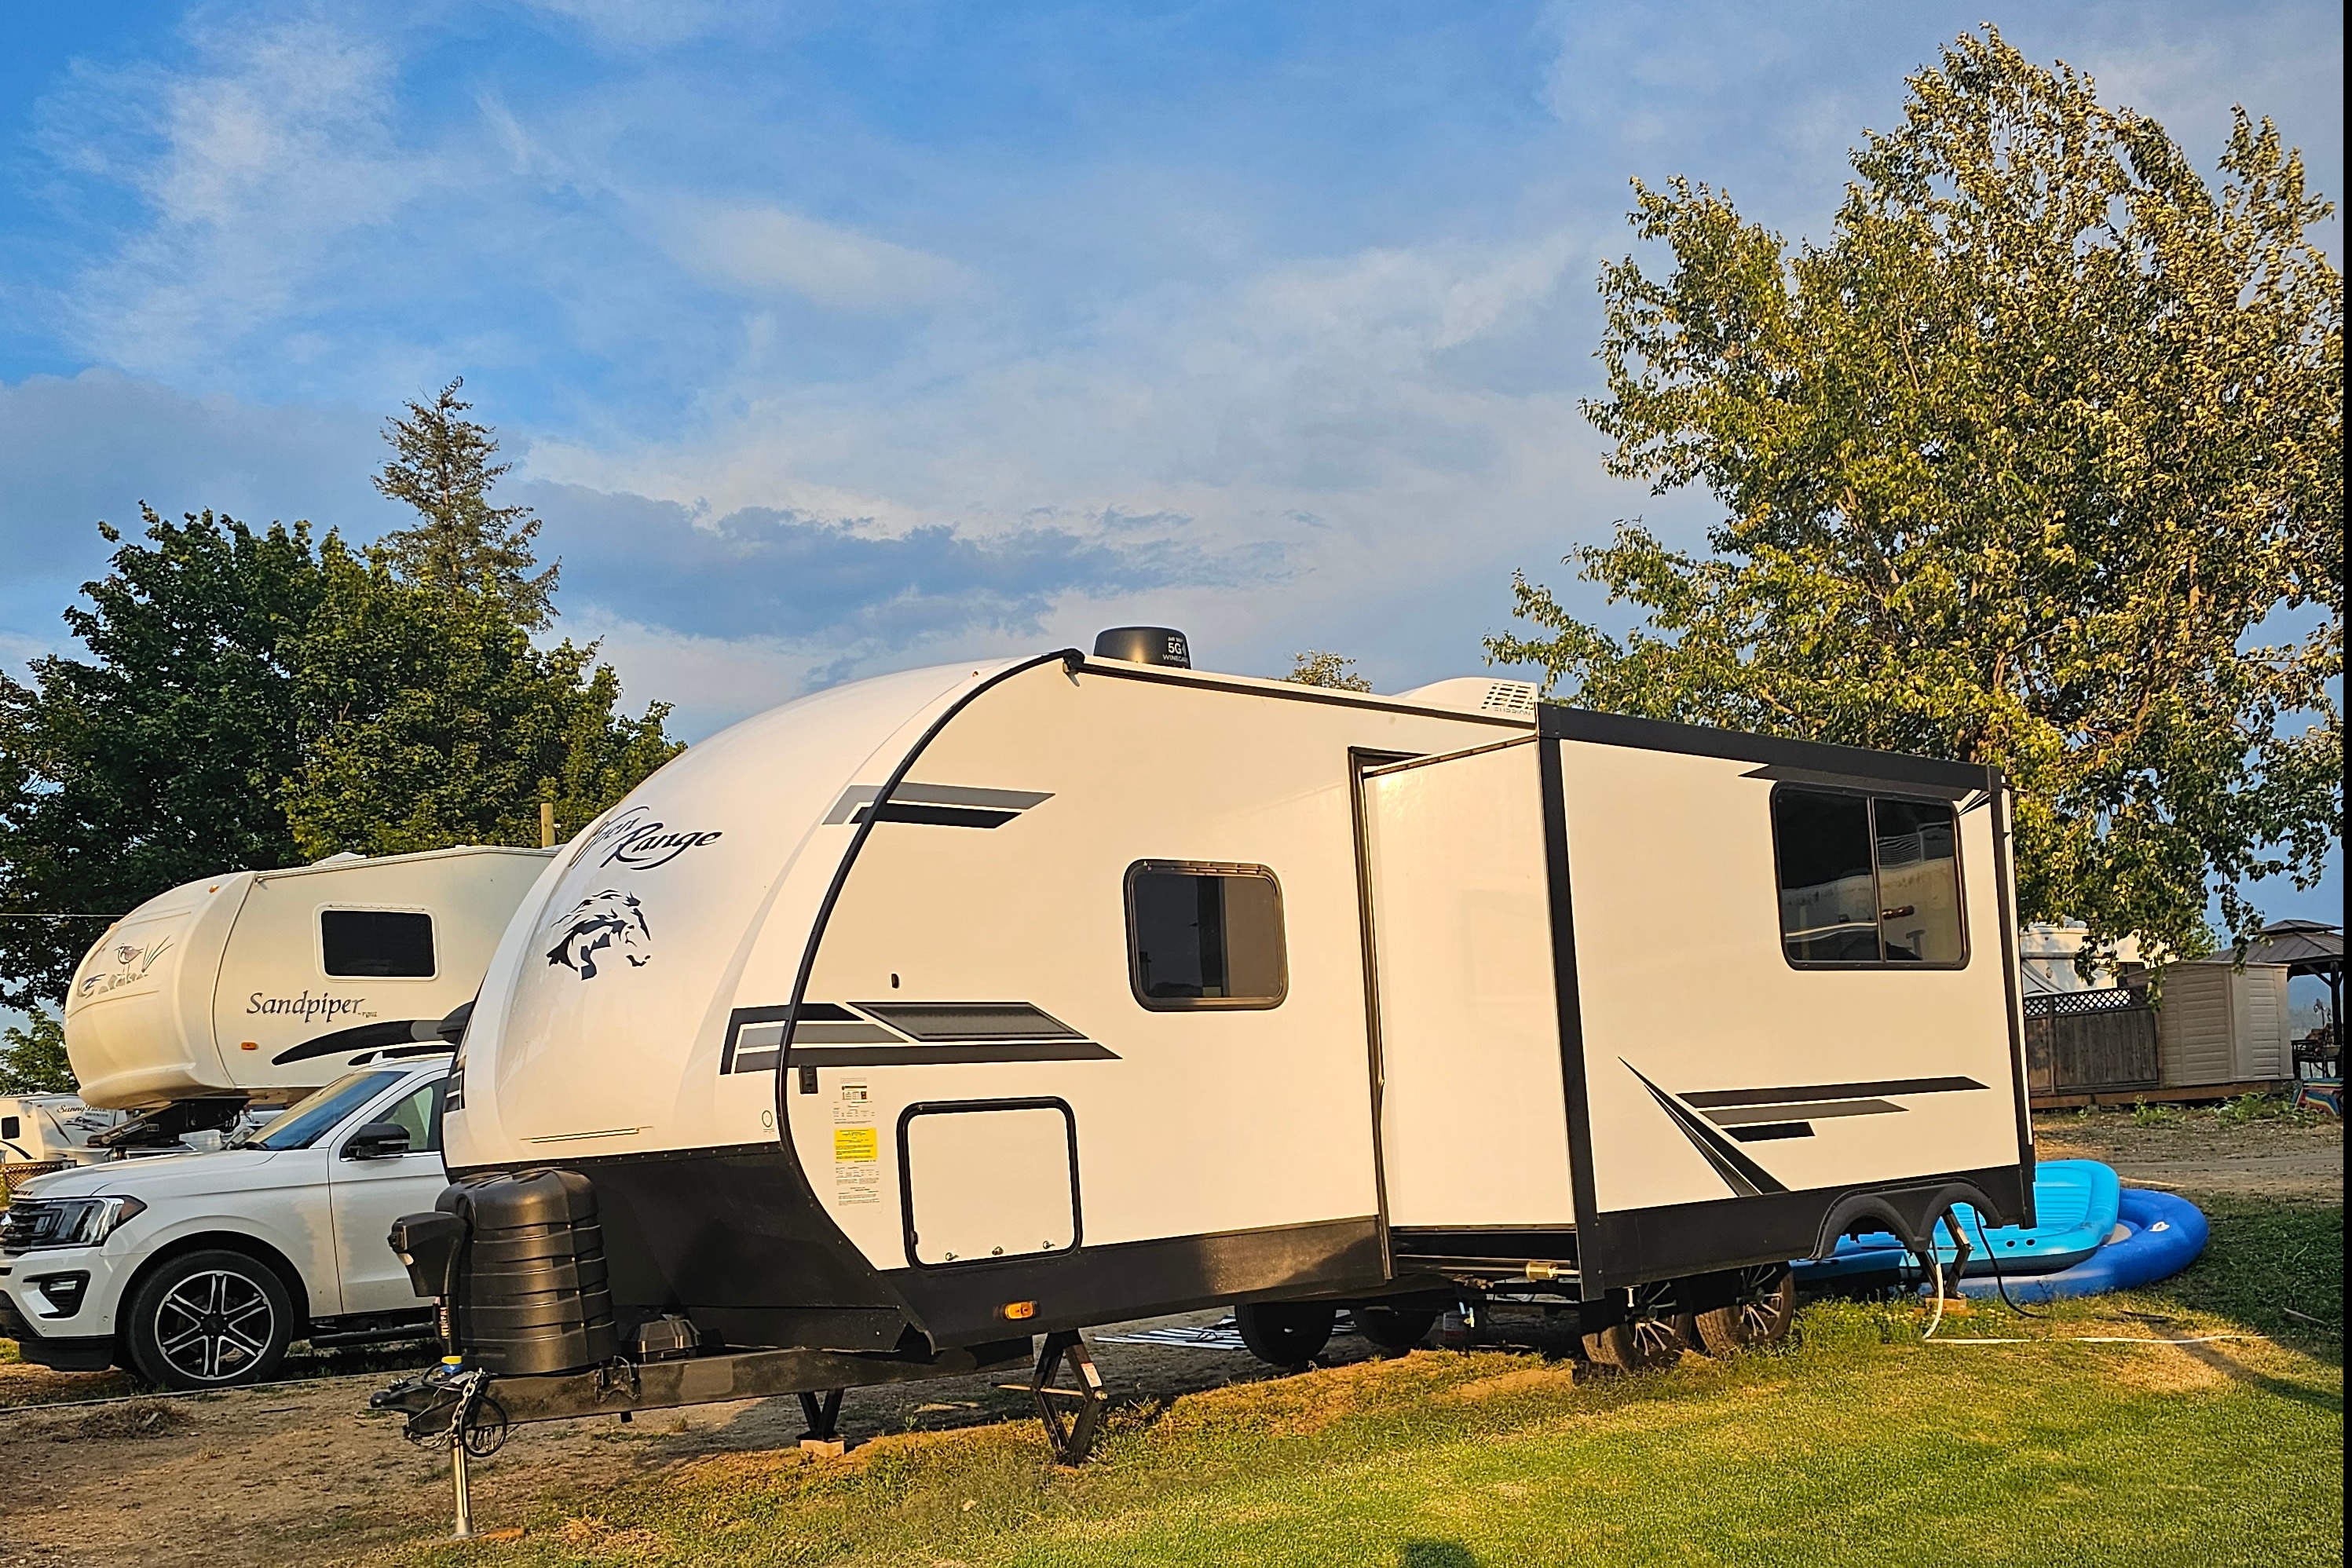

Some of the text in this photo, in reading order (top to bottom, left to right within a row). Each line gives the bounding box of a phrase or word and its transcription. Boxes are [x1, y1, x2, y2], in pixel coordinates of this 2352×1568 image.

[1168, 642, 1182, 654] 5G
[599, 822, 723, 871] Range
[246, 989, 366, 1024] Sandpiper
